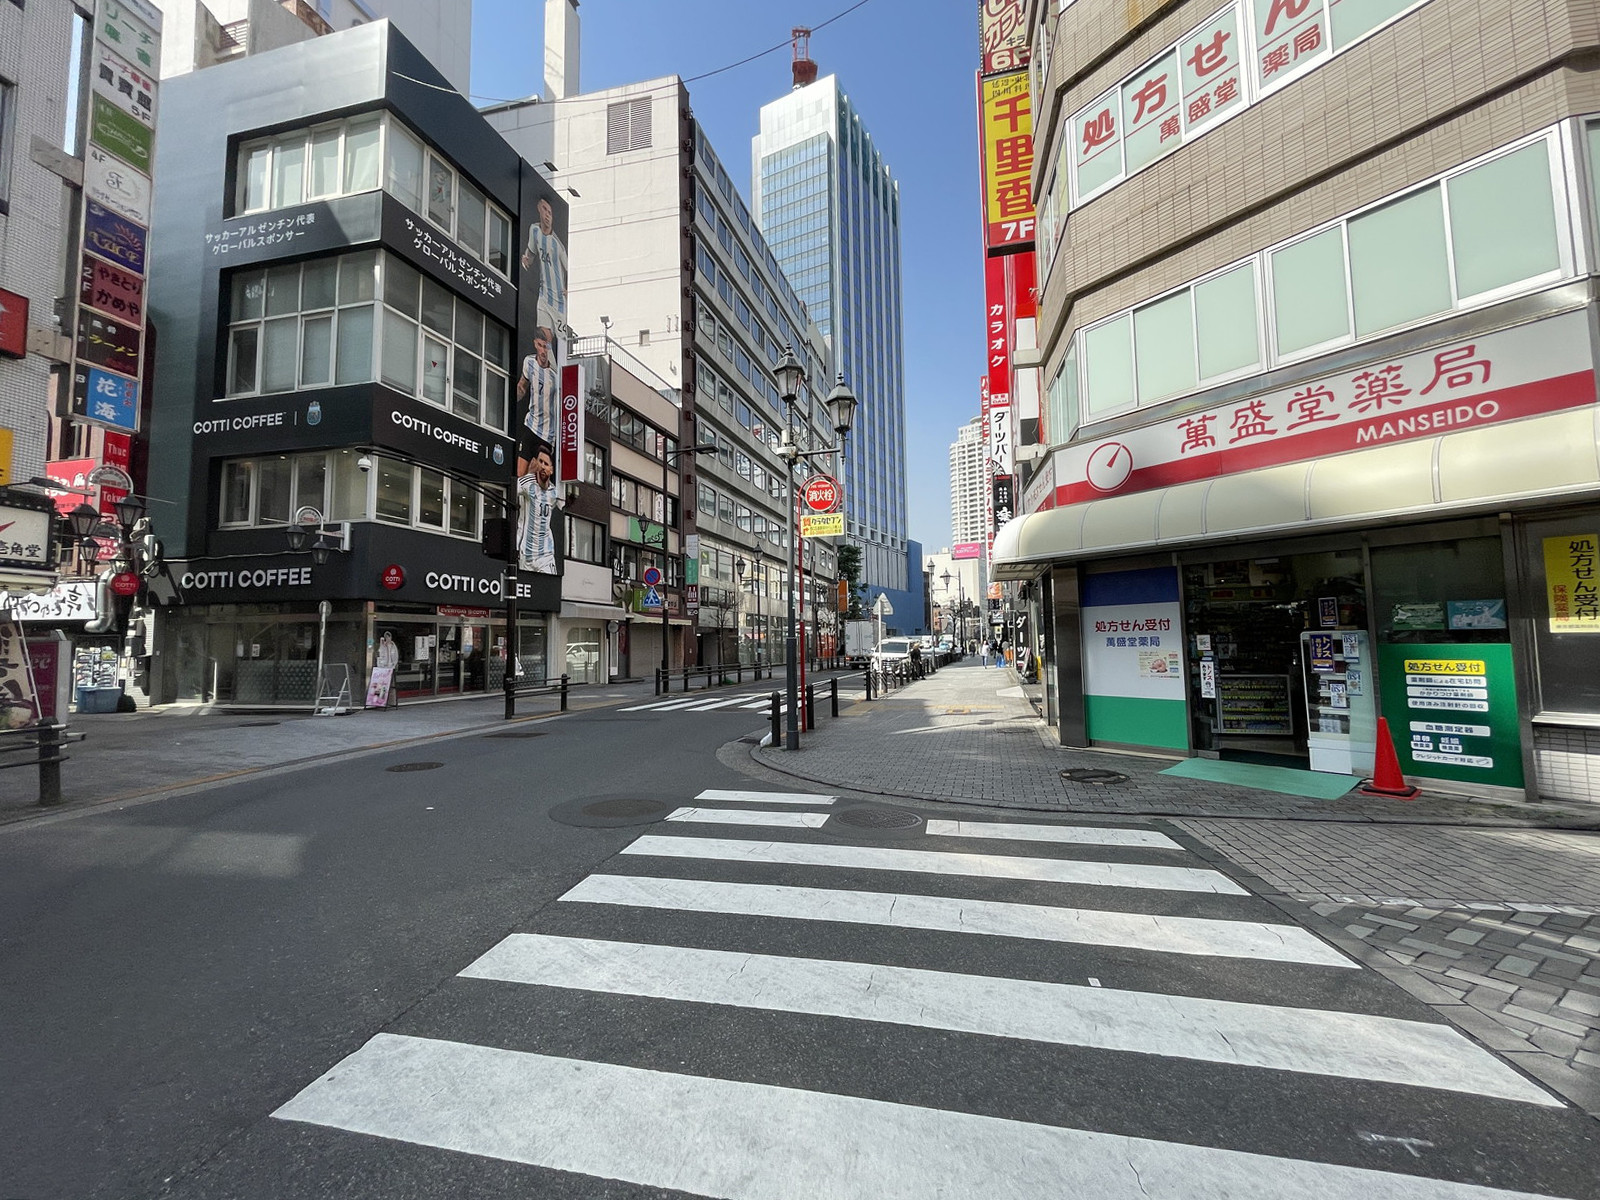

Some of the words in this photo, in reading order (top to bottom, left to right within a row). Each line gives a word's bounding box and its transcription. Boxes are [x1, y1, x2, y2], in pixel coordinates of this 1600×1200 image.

[991, 48, 1030, 70] 6F
[1160, 24, 1321, 143] 萬盛堂薬局
[993, 91, 1035, 218] 千里香
[205, 212, 316, 243] サッカーアルゼンチン代表
[1001, 219, 1034, 241] 7F
[212, 231, 306, 255] グローバルスポンサー
[405, 217, 502, 294] サッカーアルゼンチン代表
[99, 266, 141, 295] やきとり
[413, 238, 495, 299] グローバルスポンサー
[96, 288, 140, 318] かめや
[89, 334, 138, 357] ラーメン
[990, 303, 1004, 368] カラオケ
[1177, 344, 1492, 454] 萬盛堂薬局
[193, 418, 230, 435] COTTI
[233, 412, 284, 431] COFFEE
[391, 410, 431, 436] COTTI
[433, 426, 480, 454] COFFEE
[567, 412, 577, 452] COTTI
[1355, 399, 1500, 444] MANSEIDO
[994, 411, 1009, 463] ダーツバー
[539, 502, 550, 518] 10
[808, 489, 834, 502] 消火栓
[181, 570, 234, 589] COTTI
[238, 567, 312, 588] COFFEE
[425, 571, 475, 592] COTTI
[478, 579, 532, 598] COEE
[1569, 539, 1599, 621] 処方せん受付
[1095, 618, 1171, 633] 処方せん受付
[1106, 636, 1160, 647] 萬盛堂薬局
[1408, 662, 1481, 673] 処方せん受付
